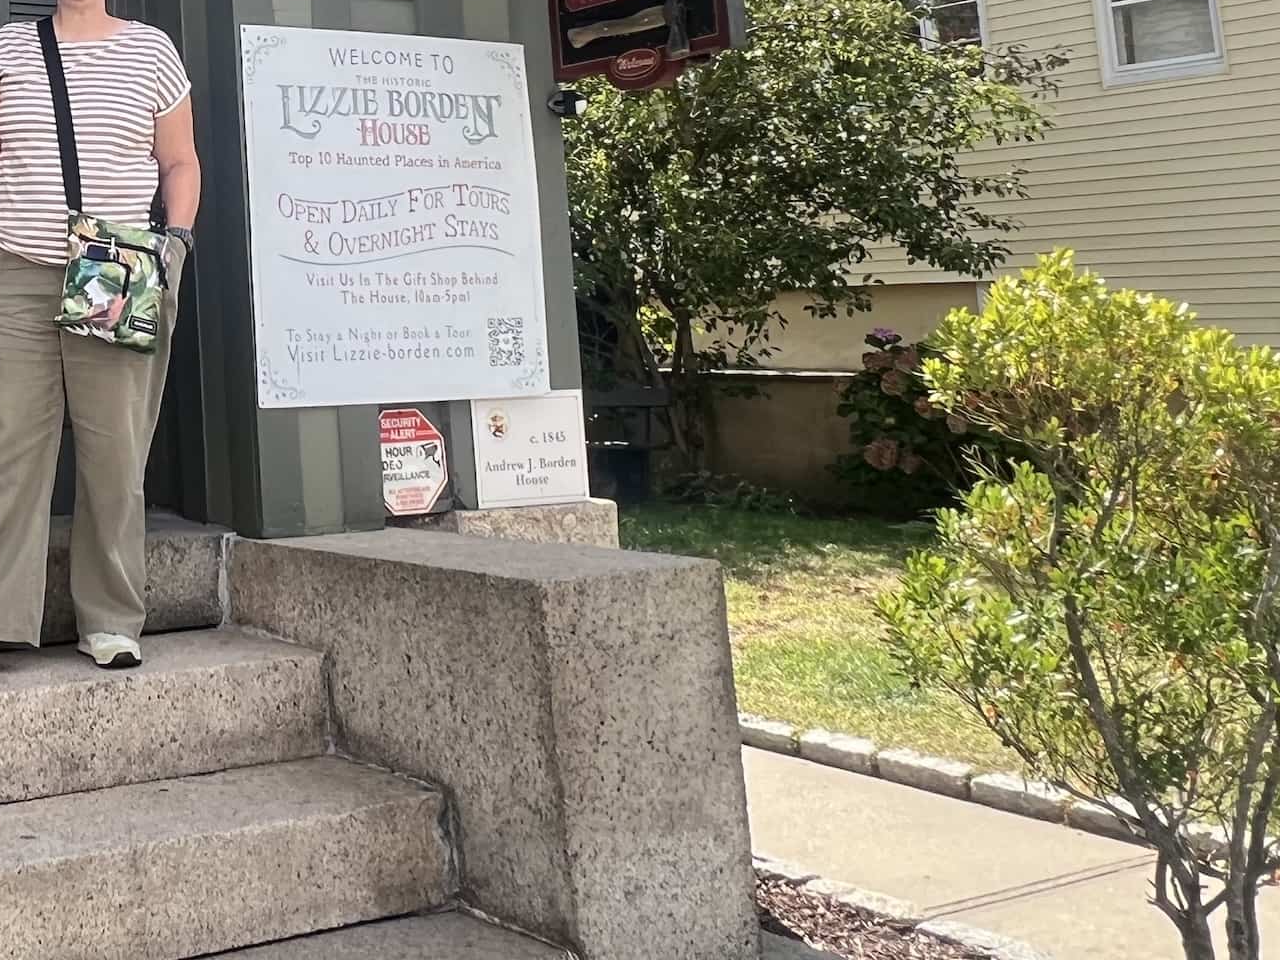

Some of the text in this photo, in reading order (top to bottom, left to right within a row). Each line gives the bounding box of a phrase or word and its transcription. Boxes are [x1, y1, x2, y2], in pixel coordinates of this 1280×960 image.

[329, 47, 455, 74] WELCOME TO
[356, 75, 432, 88] THE HISTORIC
[276, 84, 503, 144] LIZZIE BORDEN
[356, 118, 431, 146] HOUSE
[289, 152, 503, 171] Top 10 Haunted Places in America
[278, 183, 511, 224] OPEN DAILY FOR TOURS
[304, 214, 500, 256] & OVERNIGHT STAYS
[306, 271, 499, 288] Visit Us In The Gift Shop Behind
[341, 290, 366, 305] The
[369, 290, 411, 304] House,
[285, 328, 302, 343] To
[305, 328, 331, 344] Stay
[336, 331, 344, 341] a
[348, 327, 382, 344] Night
[386, 330, 398, 341] or
[402, 325, 431, 340] Book
[435, 329, 441, 339] a
[287, 344, 325, 363] Visit
[380, 416, 421, 429] SECURITY
[390, 428, 417, 440] ALERT
[542, 430, 567, 443] 1845
[384, 445, 414, 458] HOUR
[382, 460, 403, 472] DEO
[485, 456, 577, 473] Andrew J. Borden
[383, 470, 431, 483] RVEILLANCE
[515, 474, 550, 486] House
